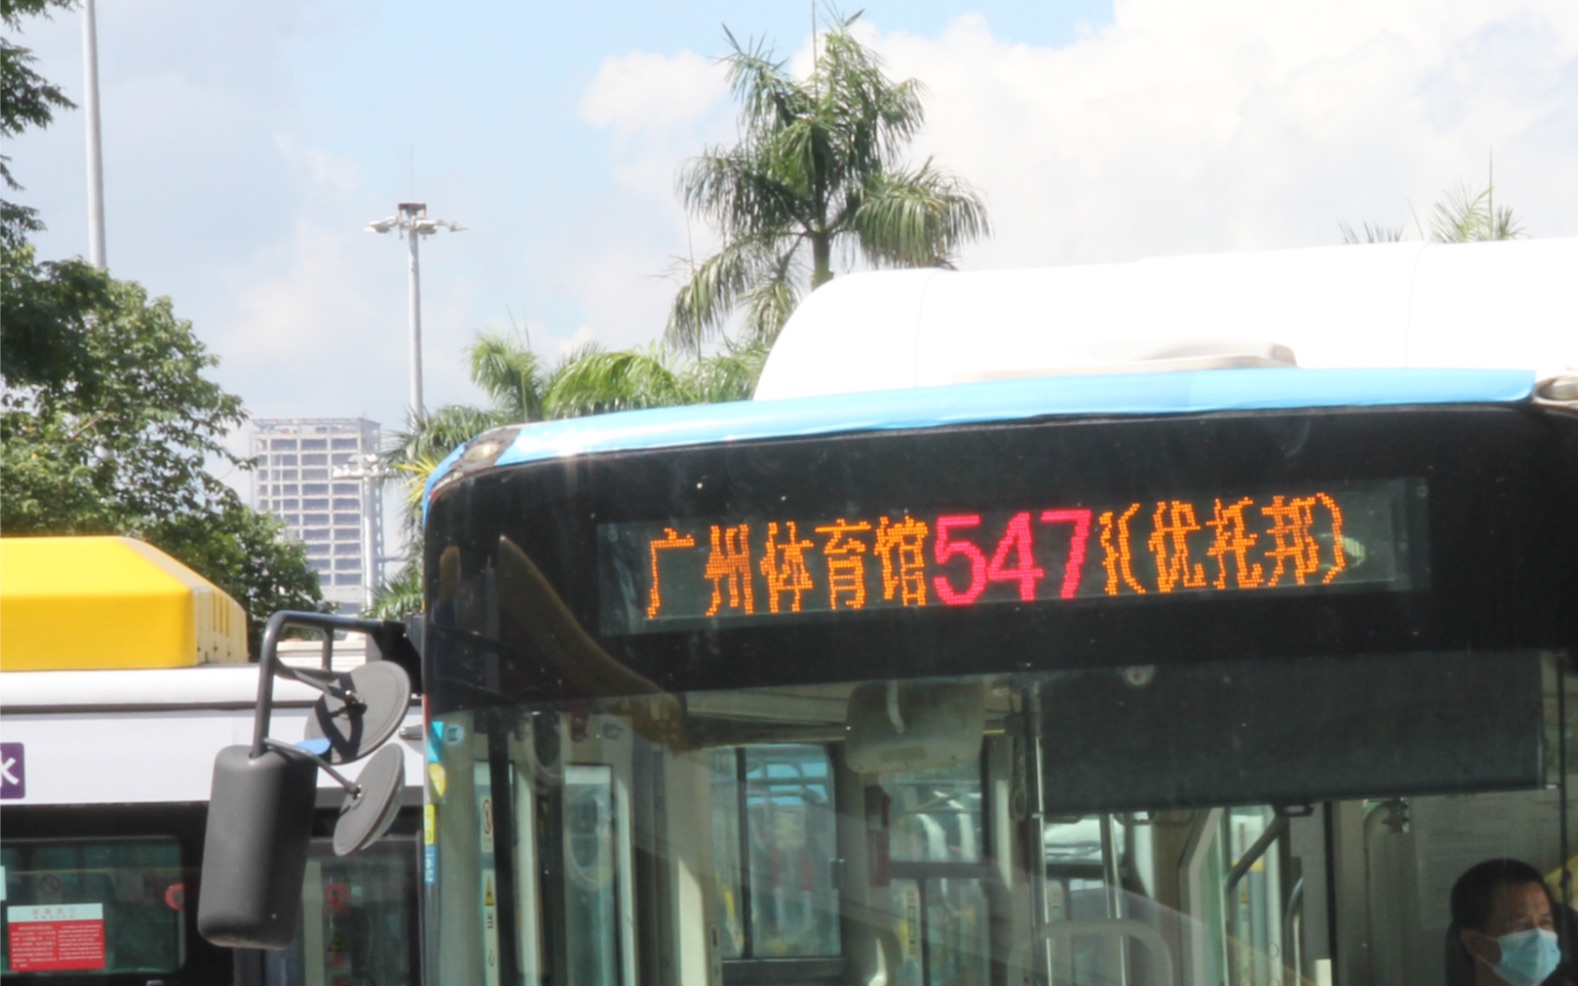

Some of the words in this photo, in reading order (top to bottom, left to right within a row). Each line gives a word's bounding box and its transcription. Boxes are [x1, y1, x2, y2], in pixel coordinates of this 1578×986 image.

[647, 515, 929, 619] 广州体育馆
[932, 509, 1093, 606] 547
